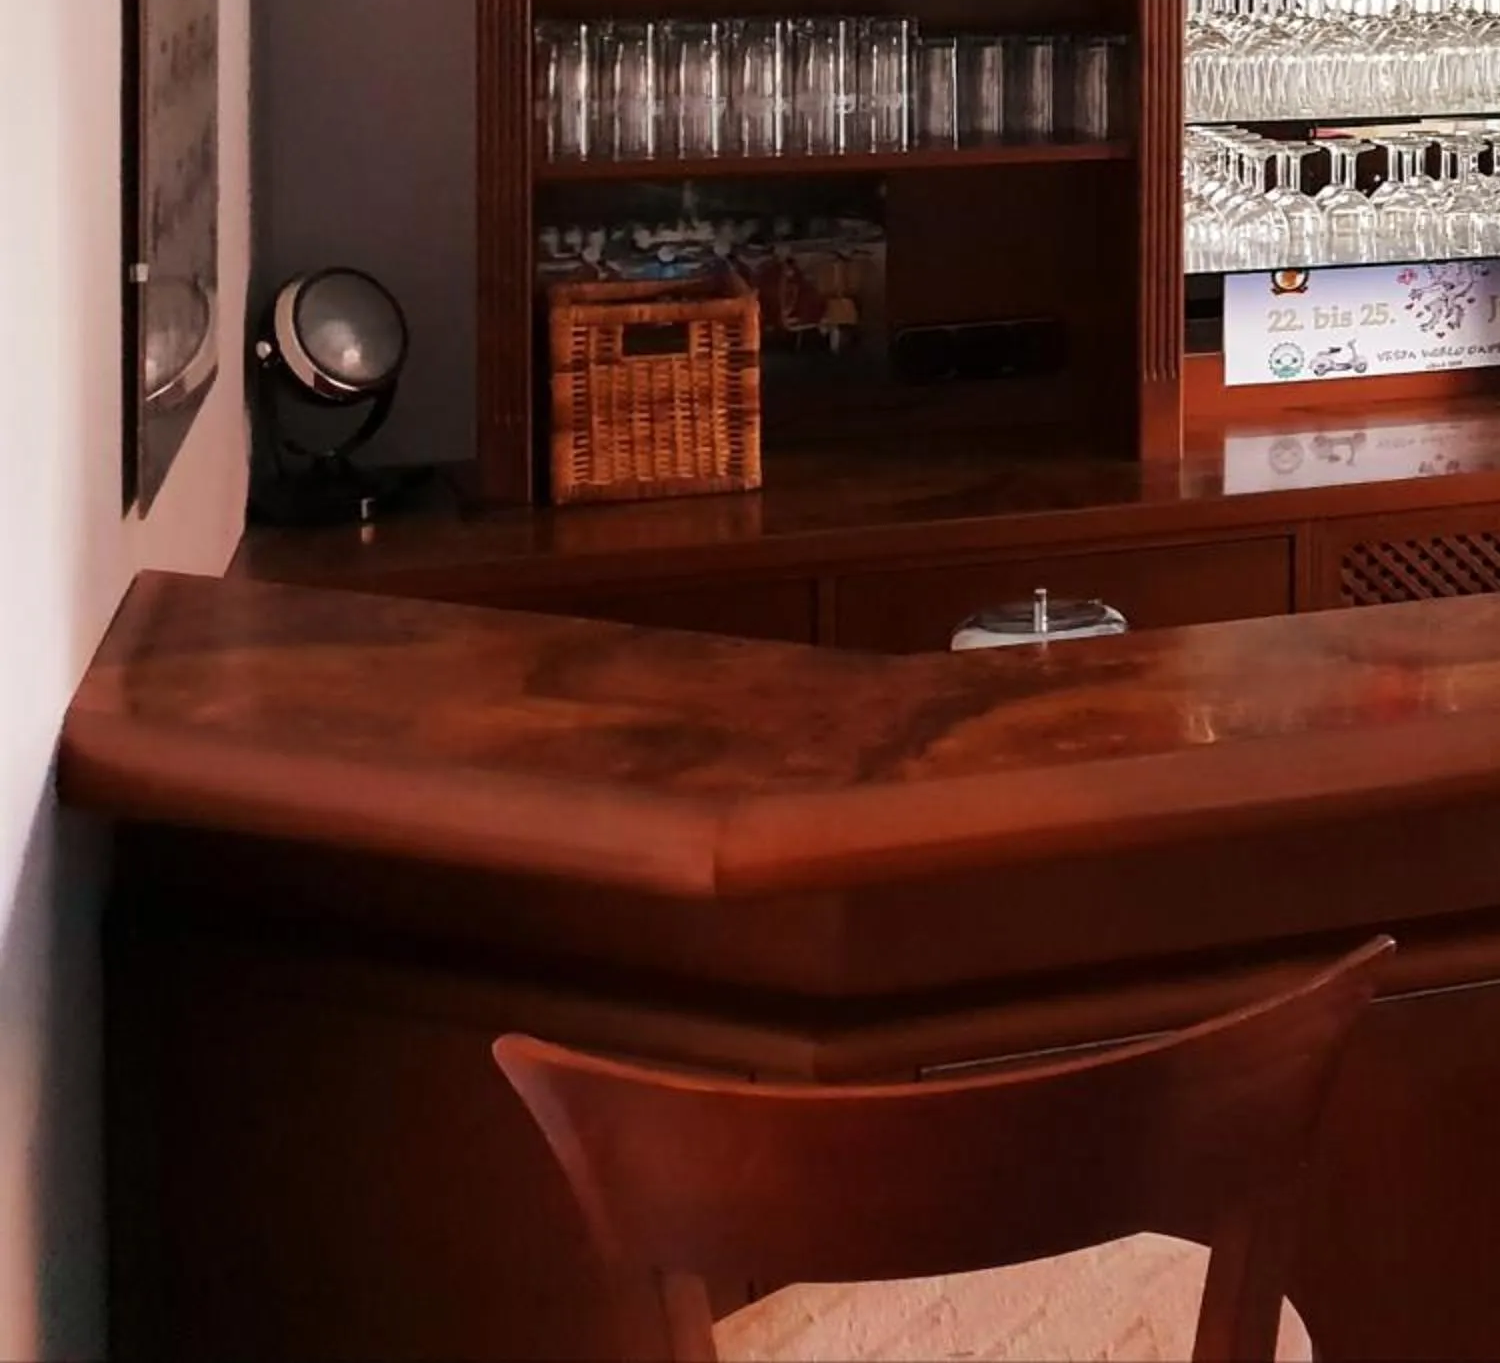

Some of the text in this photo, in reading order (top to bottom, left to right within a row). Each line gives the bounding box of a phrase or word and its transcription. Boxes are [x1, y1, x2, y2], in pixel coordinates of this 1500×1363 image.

[1268, 308, 1305, 334] 22.
[1313, 306, 1353, 330] bis
[1360, 302, 1397, 326] 25.
